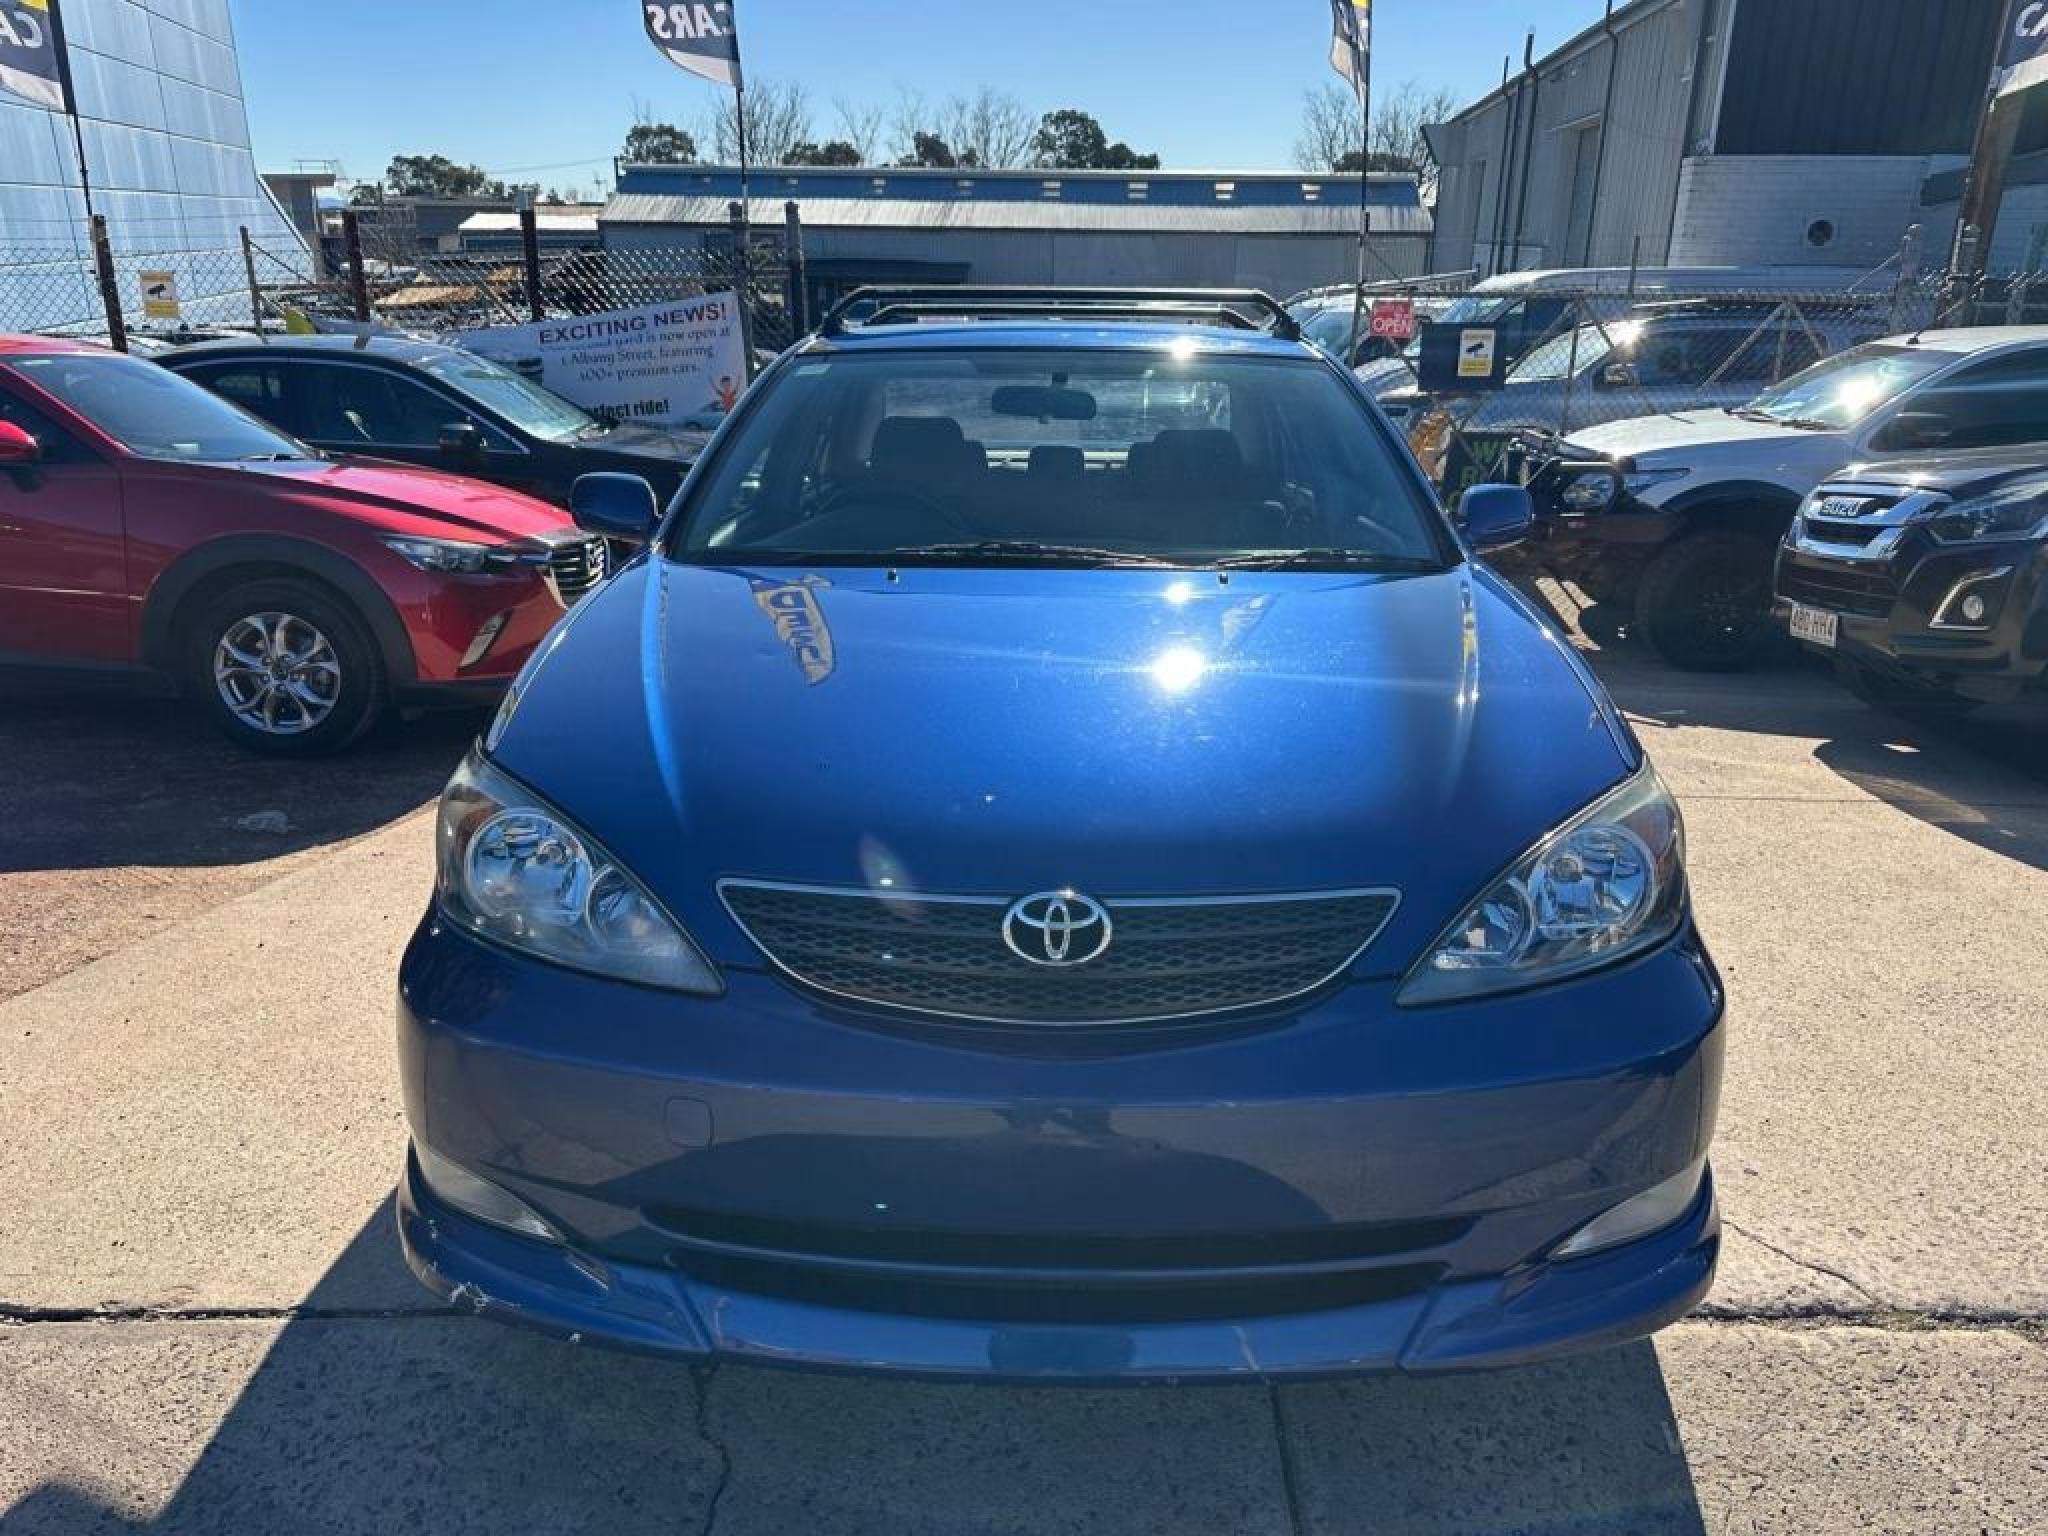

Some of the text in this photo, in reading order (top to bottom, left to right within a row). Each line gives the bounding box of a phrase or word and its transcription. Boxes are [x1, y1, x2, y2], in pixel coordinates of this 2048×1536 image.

[539, 315, 648, 345] EXCITING
[653, 302, 727, 329] NEWS!
[1374, 317, 1411, 335] OPEN
[633, 397, 670, 417] ride!
